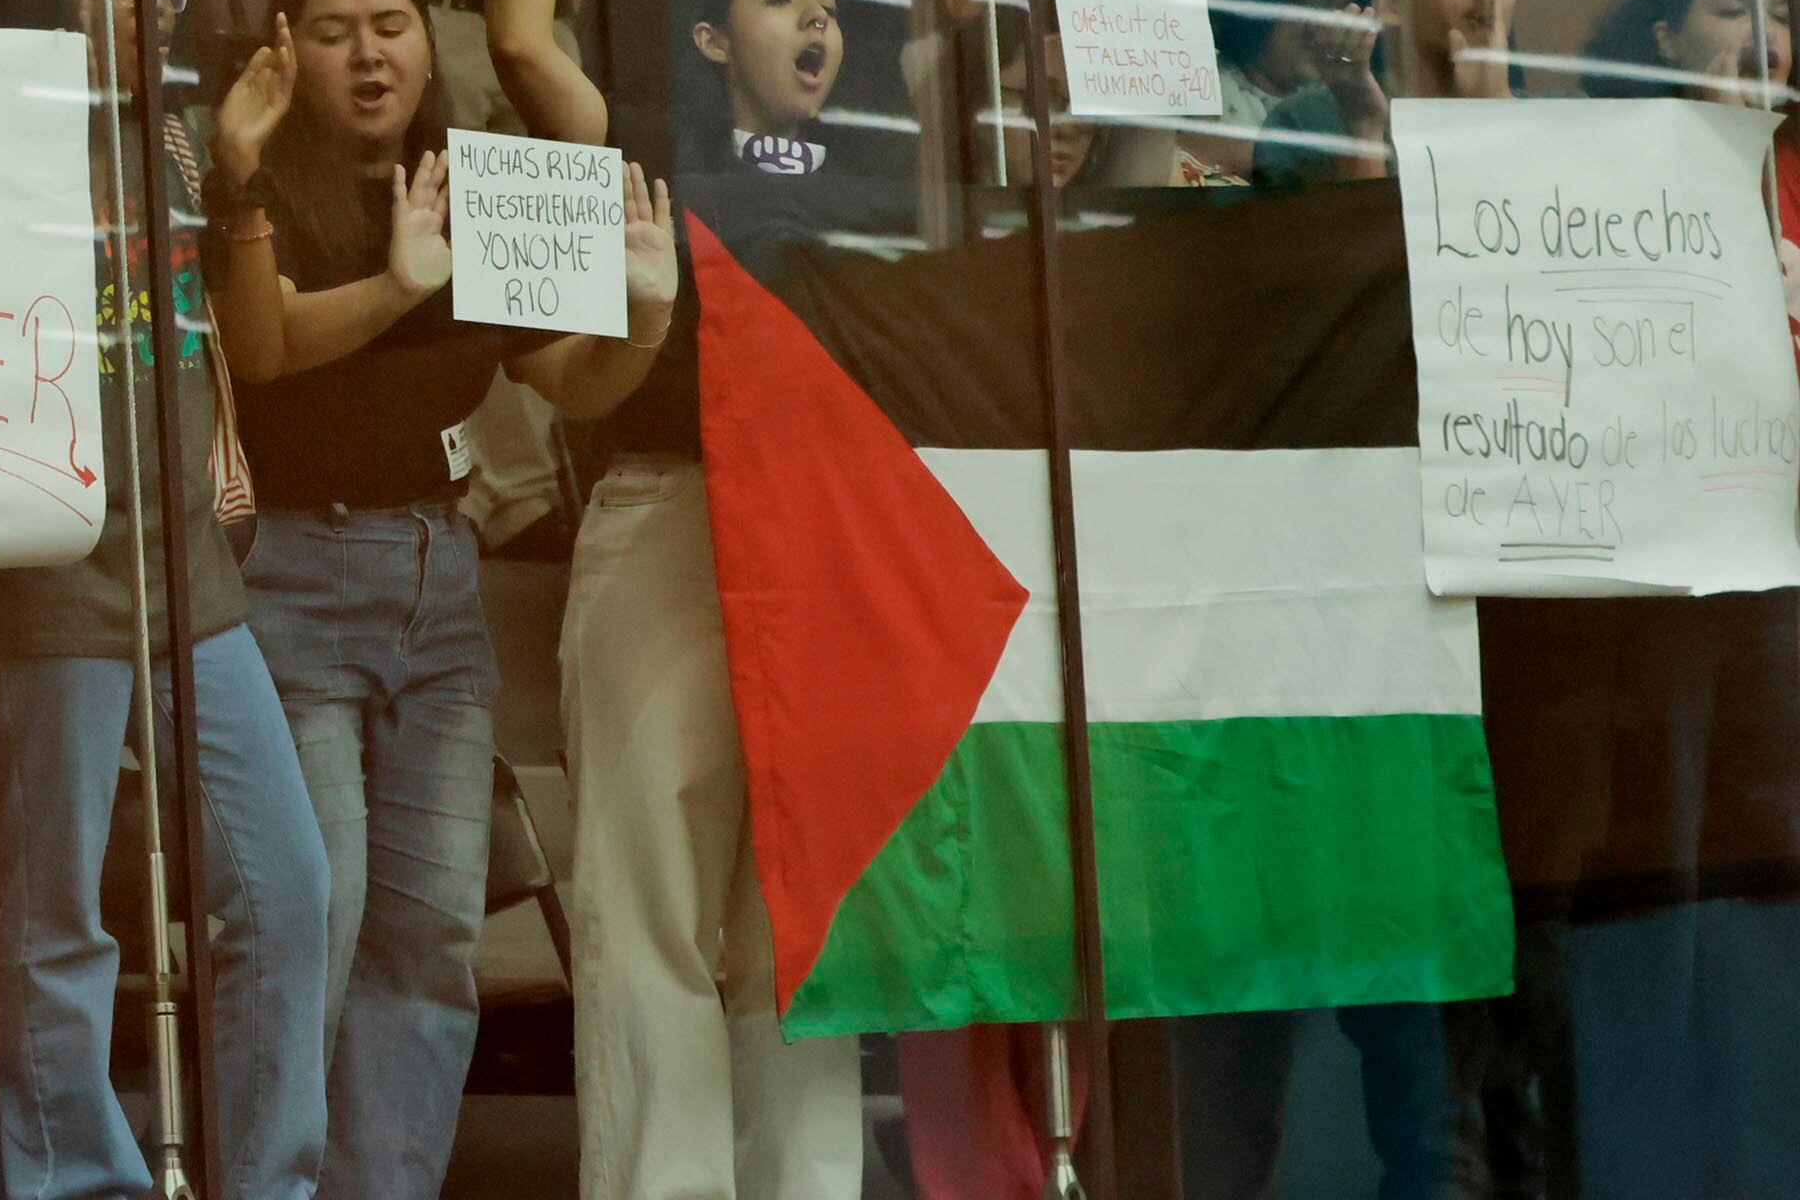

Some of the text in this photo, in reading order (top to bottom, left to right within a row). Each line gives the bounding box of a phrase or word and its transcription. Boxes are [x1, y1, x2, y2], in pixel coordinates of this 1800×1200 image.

[1071, 4, 1186, 42] déficit de
[1074, 45, 1193, 70] TALENTO
[1083, 71, 1166, 97] HUMANO
[1167, 92, 1189, 108] del
[460, 143, 611, 189] MUCHAS RISAS
[1426, 145, 1724, 262] Los derechos
[504, 276, 560, 318] RIO
[1437, 284, 1697, 408] de hoy son el
[1442, 397, 1590, 470] resultado
[1601, 403, 1639, 469] de
[1662, 400, 1698, 462] las
[1444, 472, 1624, 543] de AYER
